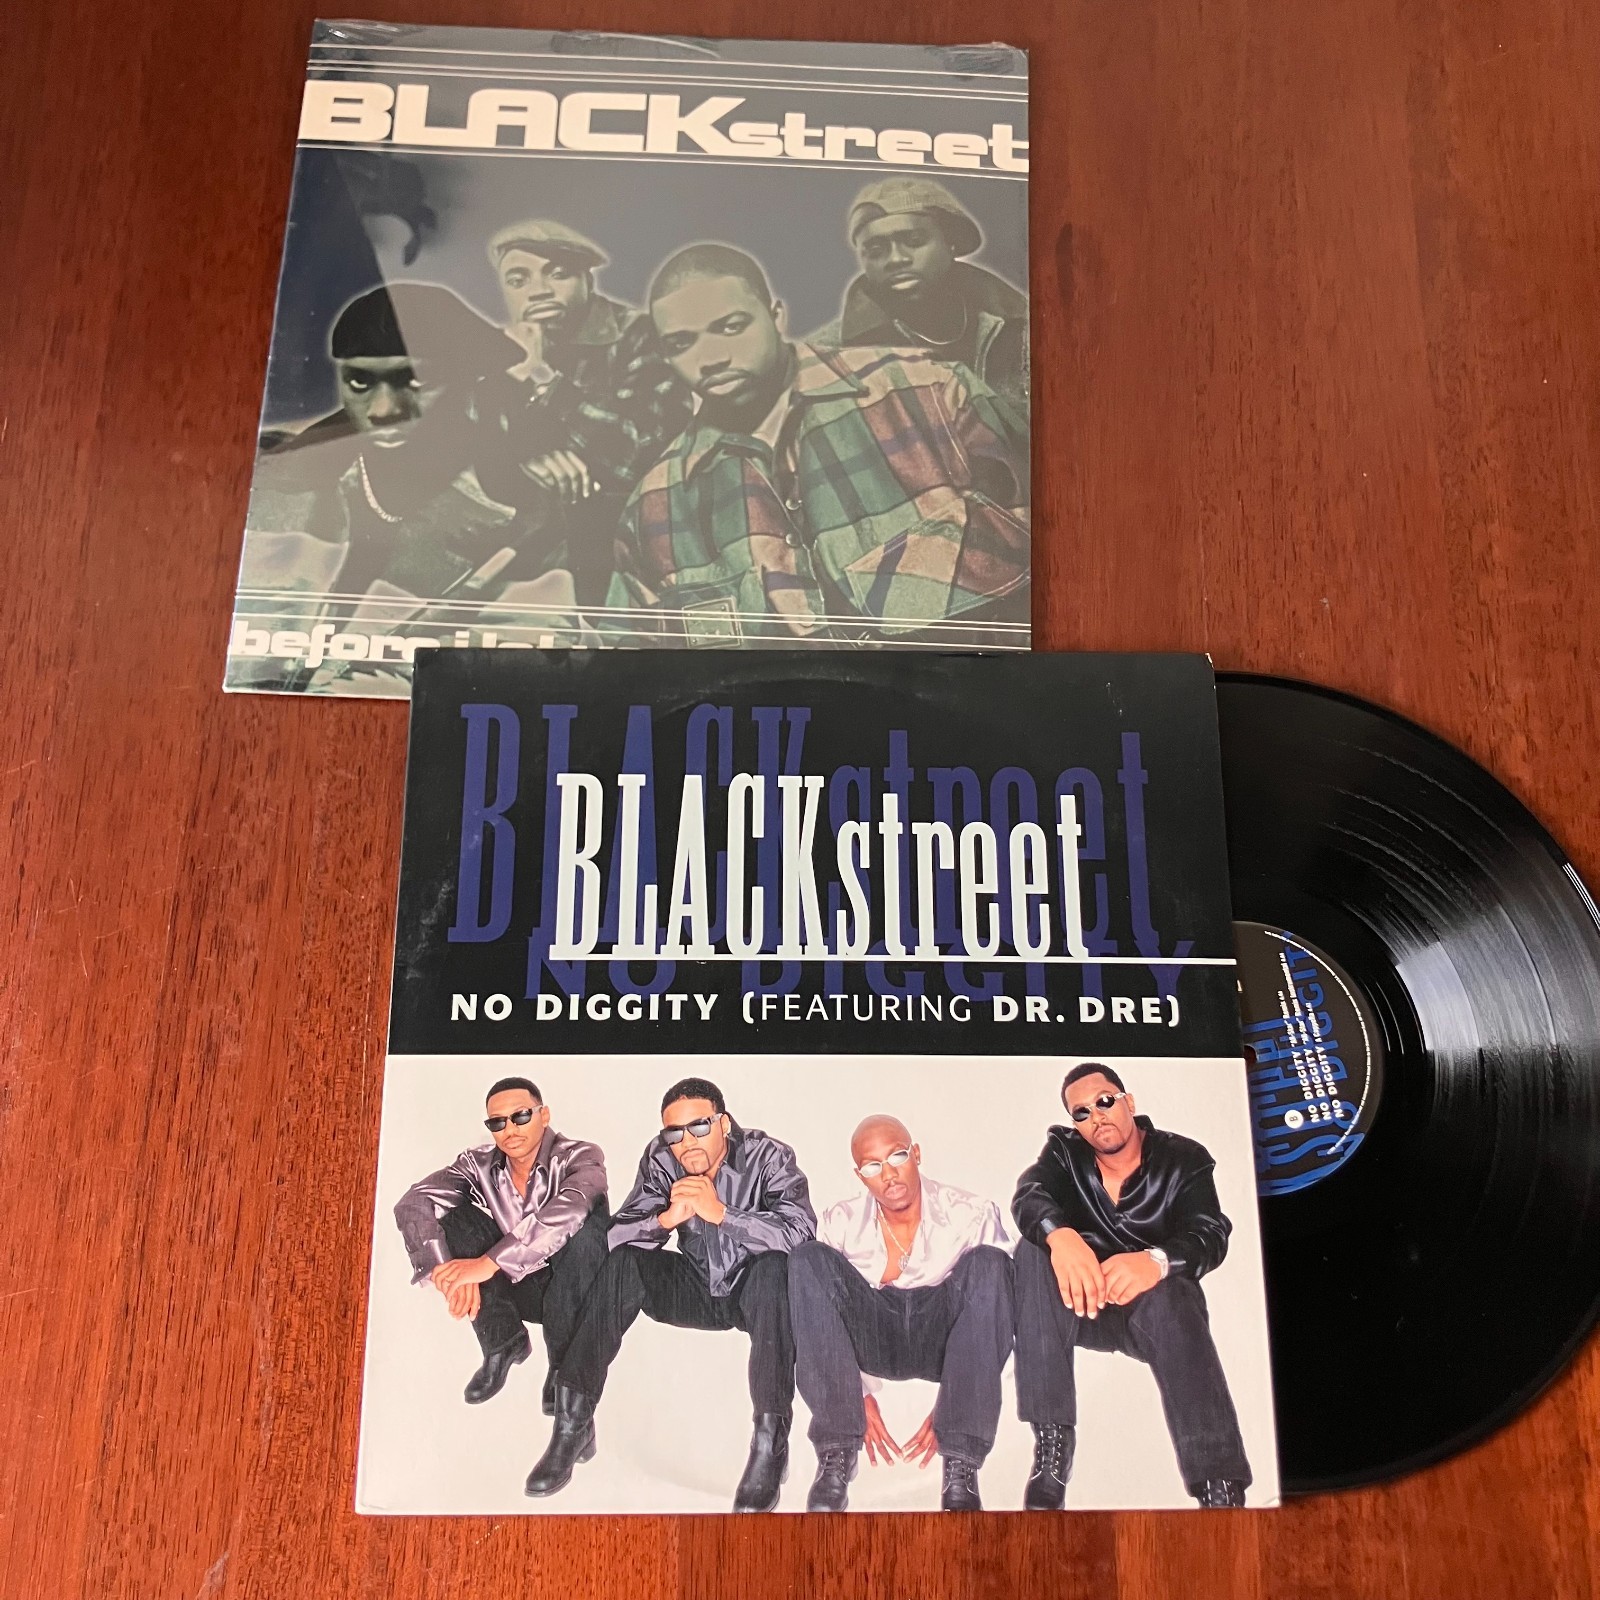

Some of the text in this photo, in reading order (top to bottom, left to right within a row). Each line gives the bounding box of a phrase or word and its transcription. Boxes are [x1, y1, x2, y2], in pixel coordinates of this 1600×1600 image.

[297, 78, 1029, 174] BLACKstreet
[550, 773, 1088, 959] BLACKstreet
[450, 991, 1180, 1028] NO DIGGITY (FEATURING DR. DRE)
[1291, 1051, 1313, 1100] DIGGITY
[1303, 1048, 1325, 1098] DIGGITY
[1315, 1046, 1337, 1095] DIGGITY
[1308, 1104, 1320, 1123] NO
[1320, 1102, 1332, 1120] NO
[1332, 1099, 1344, 1118] NO
